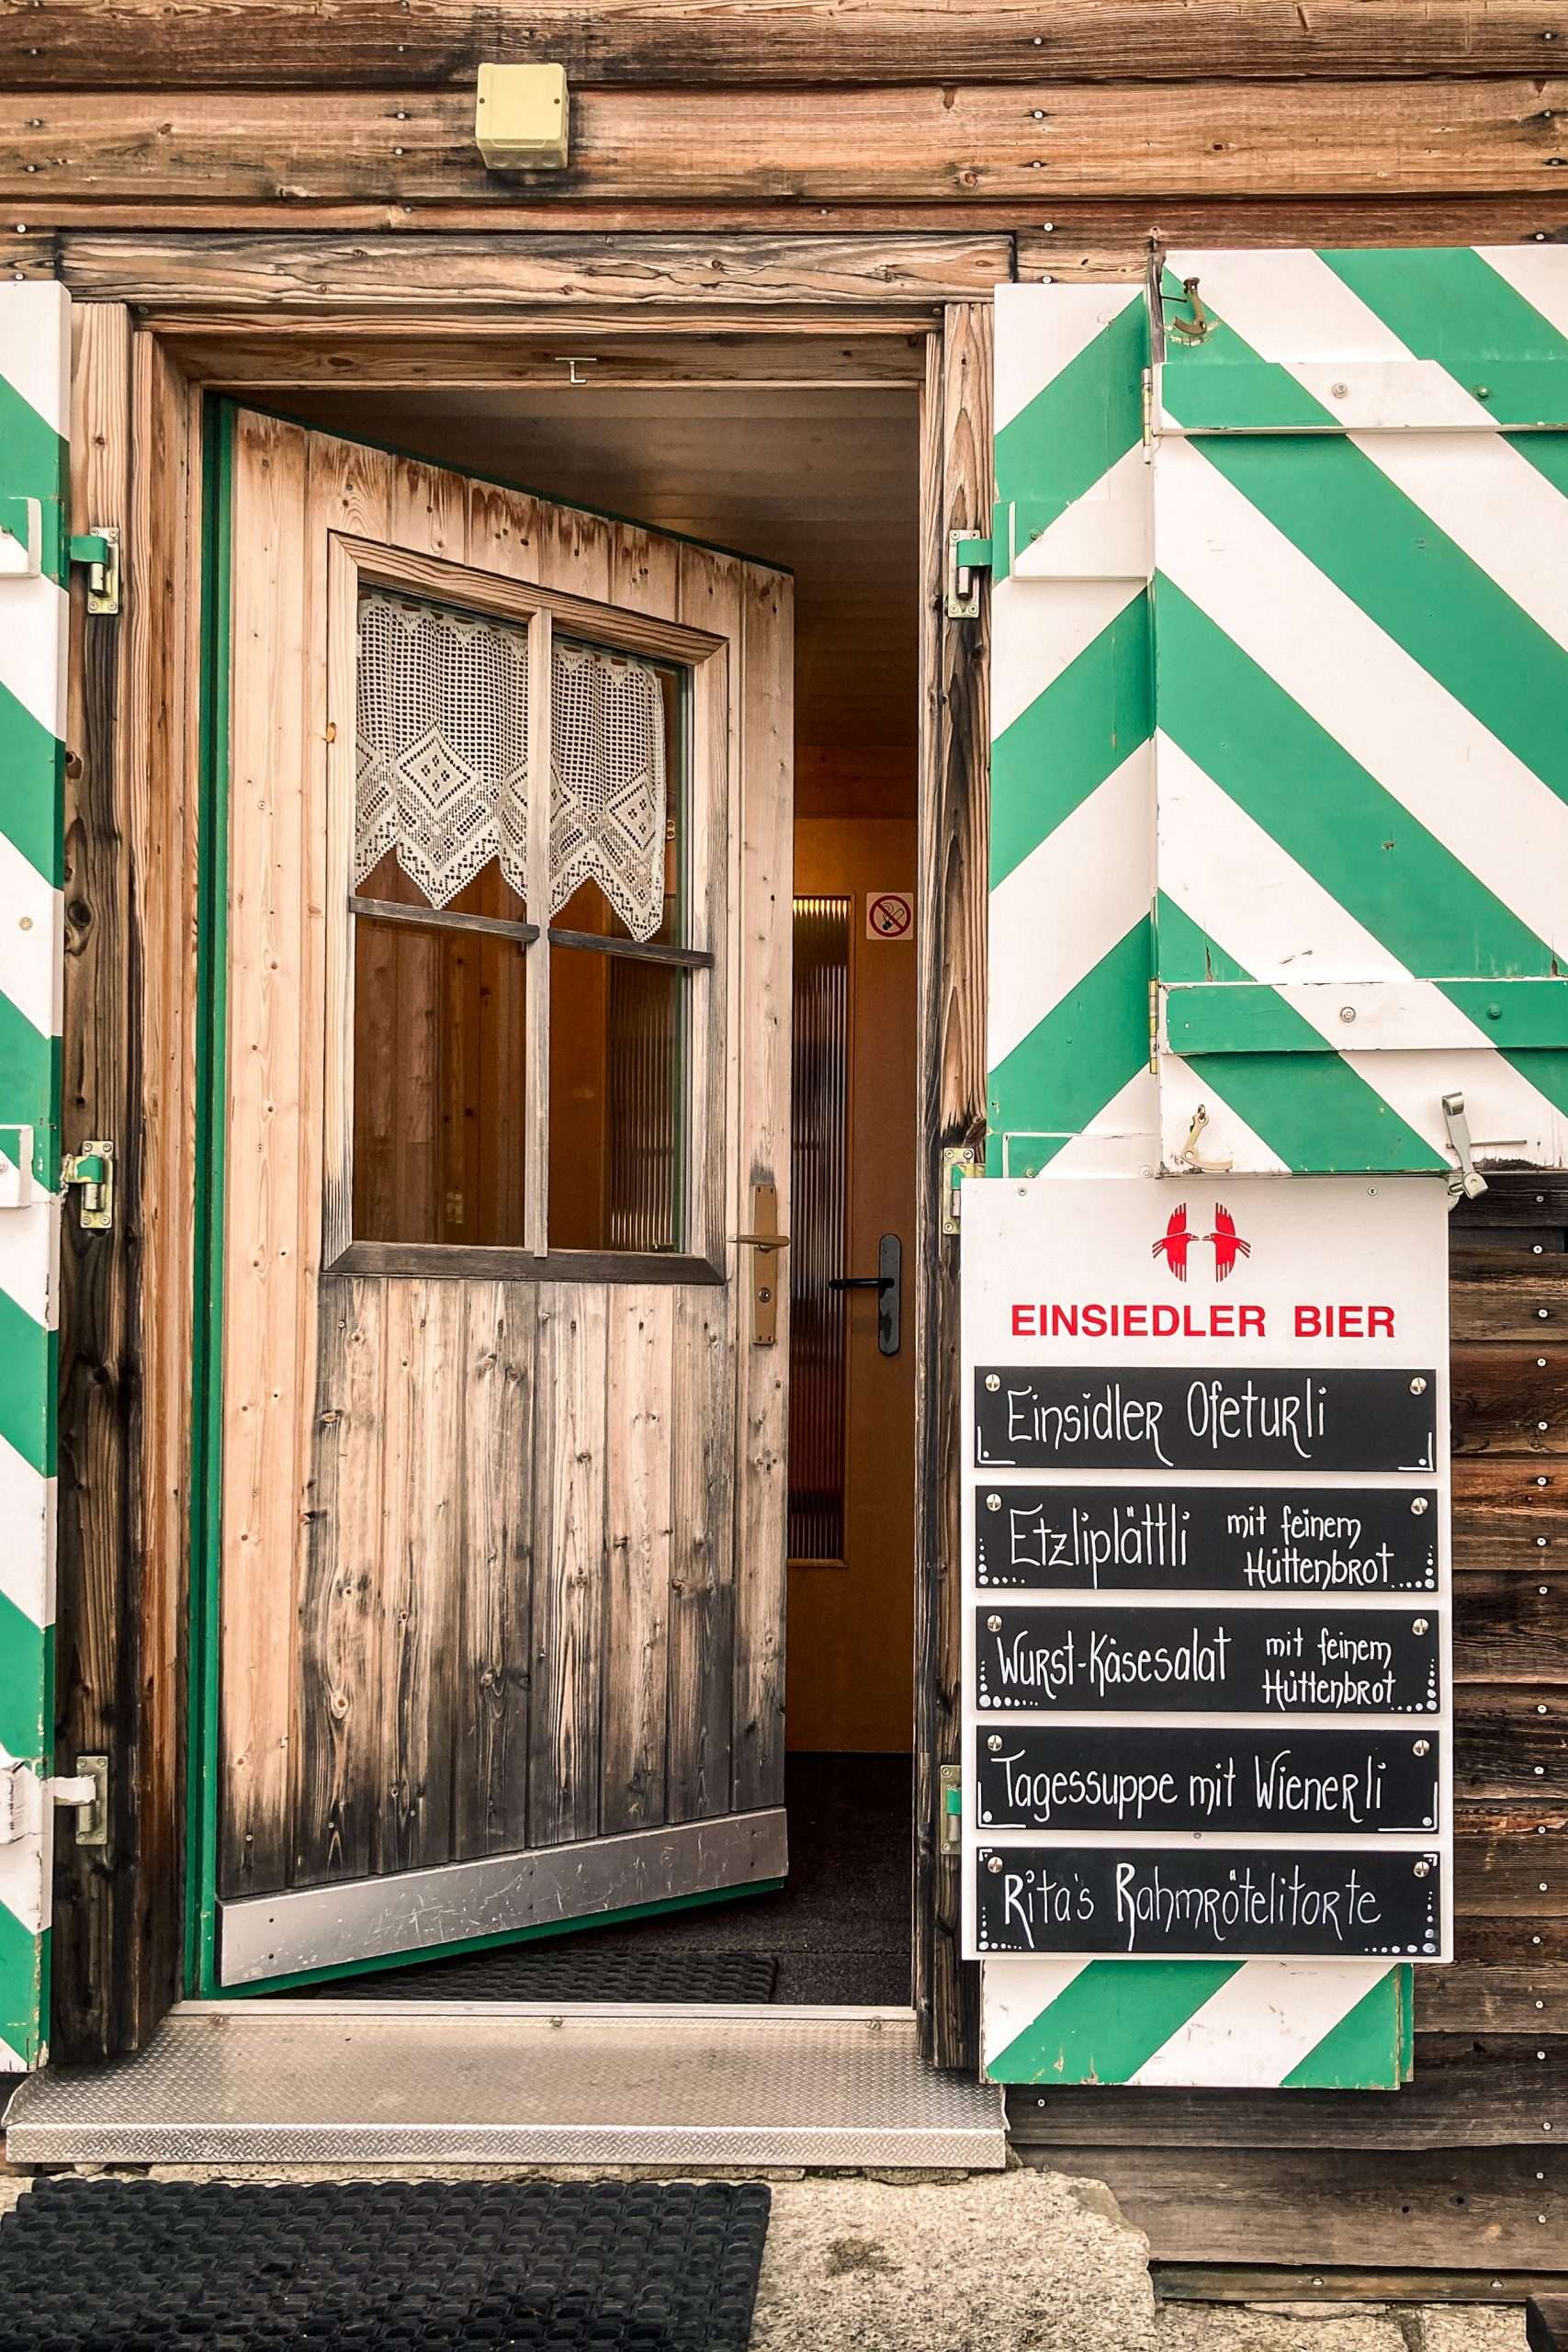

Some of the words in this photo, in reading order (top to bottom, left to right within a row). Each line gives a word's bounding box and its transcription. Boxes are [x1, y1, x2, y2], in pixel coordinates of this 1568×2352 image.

[1011, 1303, 1266, 1338] EINSIEDLER
[1293, 1305, 1395, 1339] BIER
[1010, 1502, 1192, 1589] Etzliplättli
[1227, 1505, 1268, 1539] mit
[1280, 1505, 1361, 1551] feinem
[1266, 1626, 1304, 1657] mit
[1316, 1627, 1392, 1669] feinem
[990, 1749, 1179, 1822] Tagessuppe
[1190, 1758, 1236, 1815] mit
[1004, 1869, 1095, 1949] Rita's
